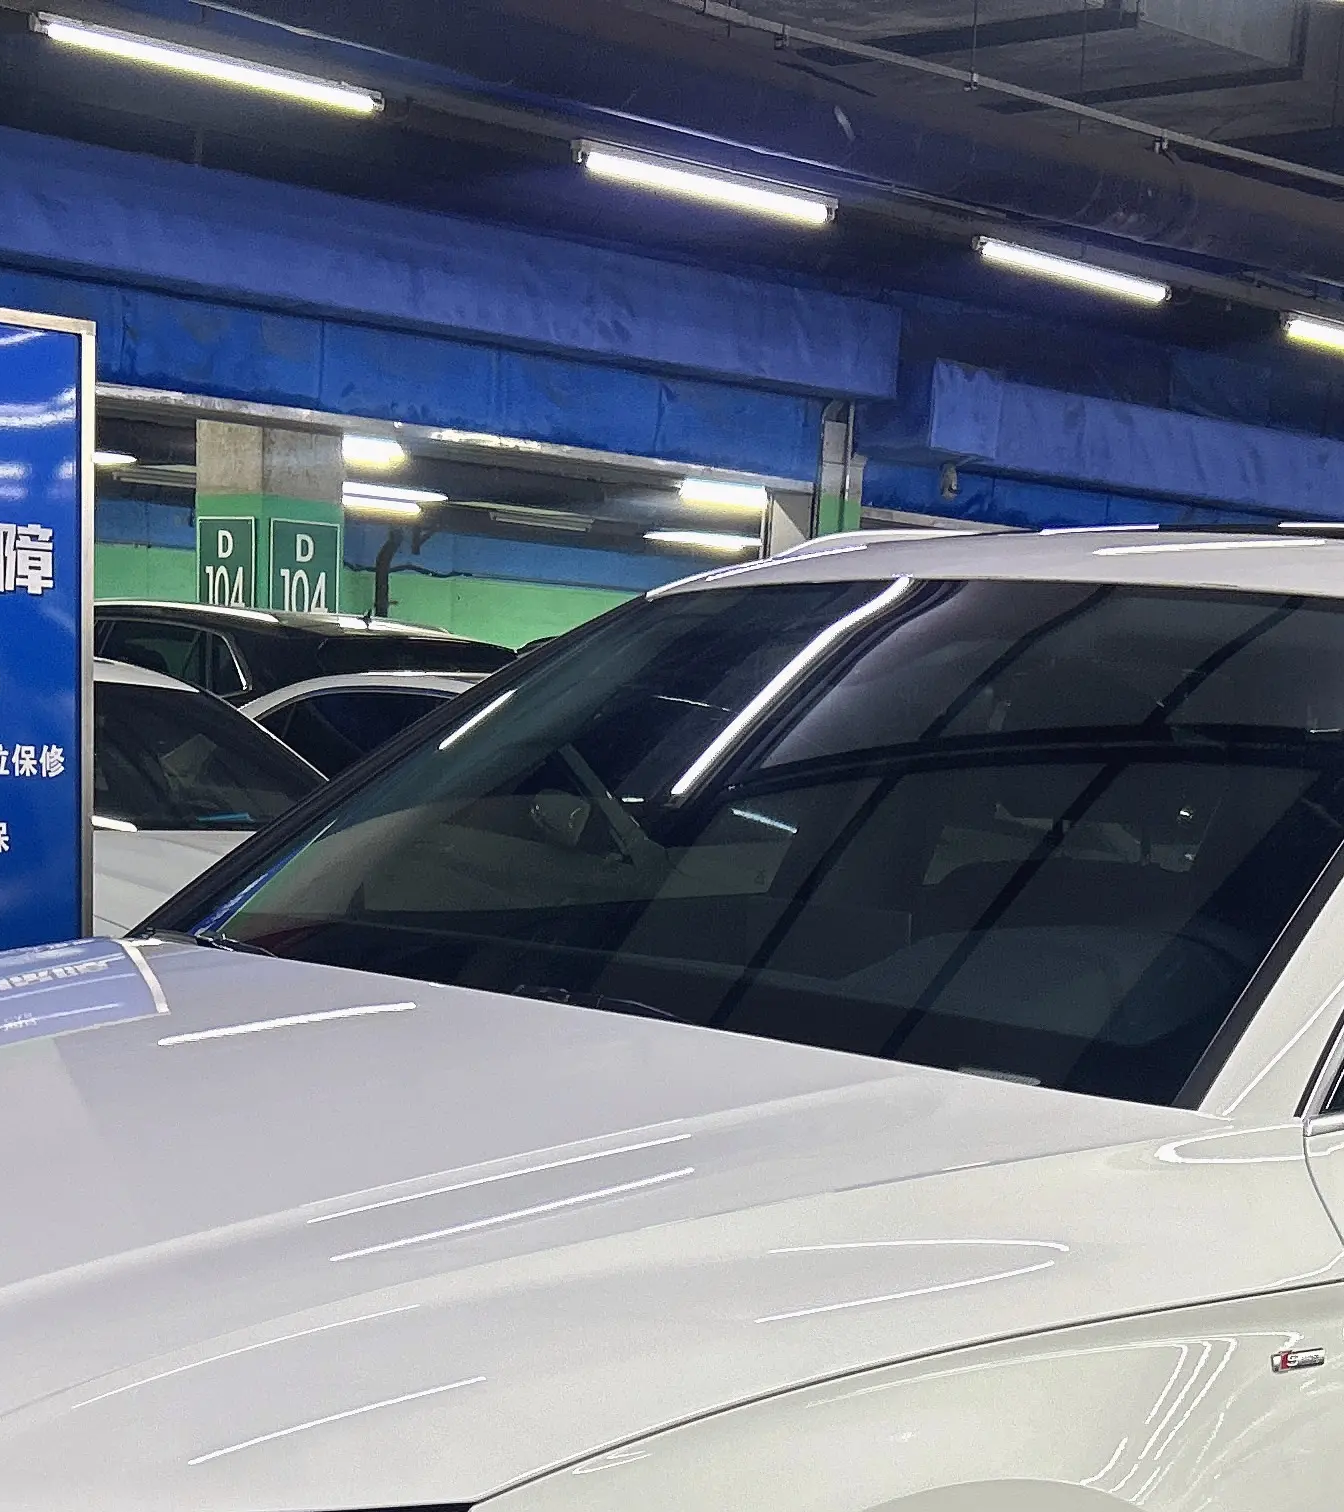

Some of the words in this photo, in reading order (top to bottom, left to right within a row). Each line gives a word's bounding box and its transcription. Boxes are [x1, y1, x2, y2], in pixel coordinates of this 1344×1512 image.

[217, 529, 234, 559] D
[295, 533, 315, 563] D
[205, 565, 246, 609] 104
[280, 568, 329, 613] 104
